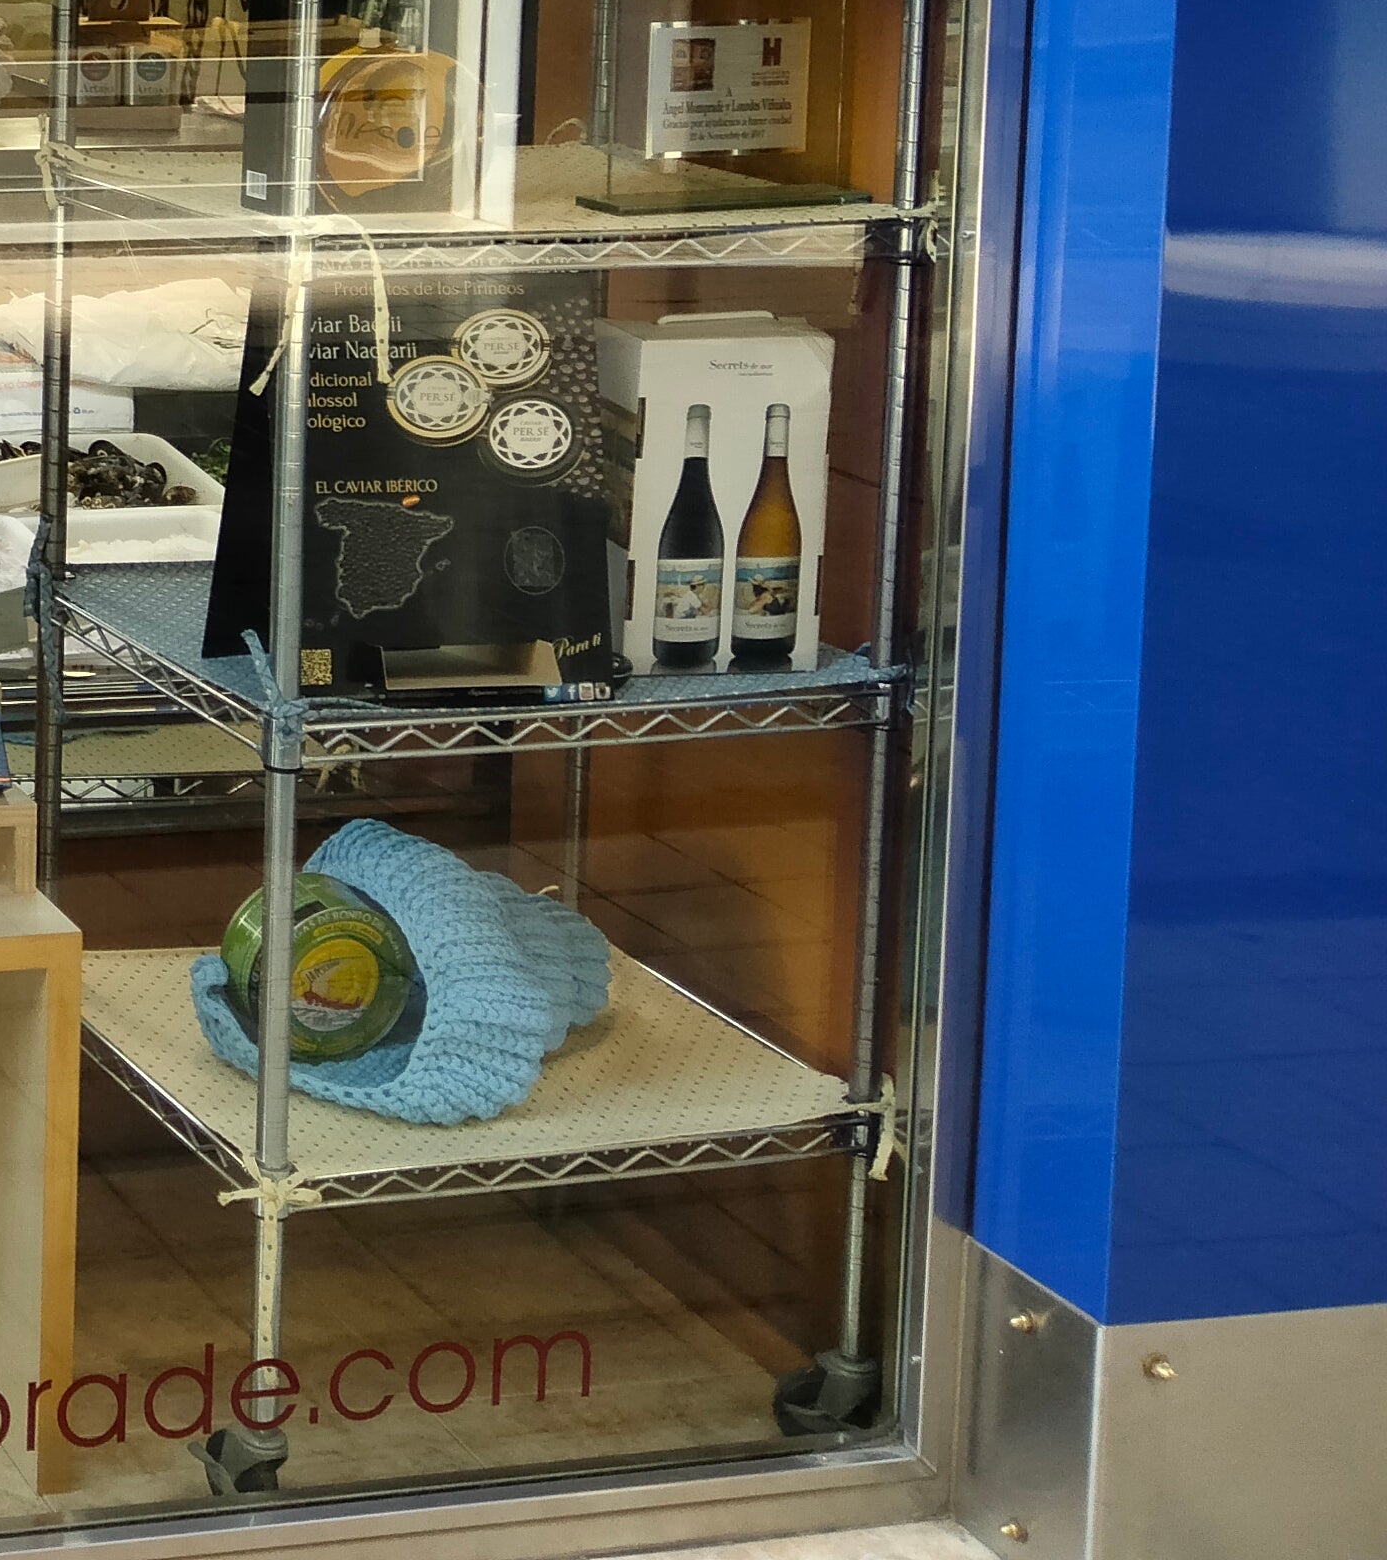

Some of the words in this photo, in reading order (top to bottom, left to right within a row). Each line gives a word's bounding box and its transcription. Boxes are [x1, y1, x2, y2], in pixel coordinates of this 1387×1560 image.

[762, 38, 782, 66] H
[334, 281, 409, 297] Produtos
[414, 282, 434, 296] de
[437, 282, 459, 296] los
[464, 281, 525, 296] Pirineos
[309, 316, 343, 333] viar
[349, 314, 402, 333] Baii
[308, 342, 341, 360] viar
[346, 340, 418, 359] Nacarii
[483, 342, 505, 351] PER
[708, 360, 748, 370] Secrets
[310, 371, 373, 387] dicional
[308, 392, 358, 408] lossol
[419, 392, 440, 401] PER
[307, 413, 367, 433] ológico
[513, 427, 534, 436] PER
[315, 481, 331, 493] EL
[335, 480, 382, 493] CAVIAR
[386, 478, 438, 493] IBÉRICO
[552, 636, 589, 660] Para
